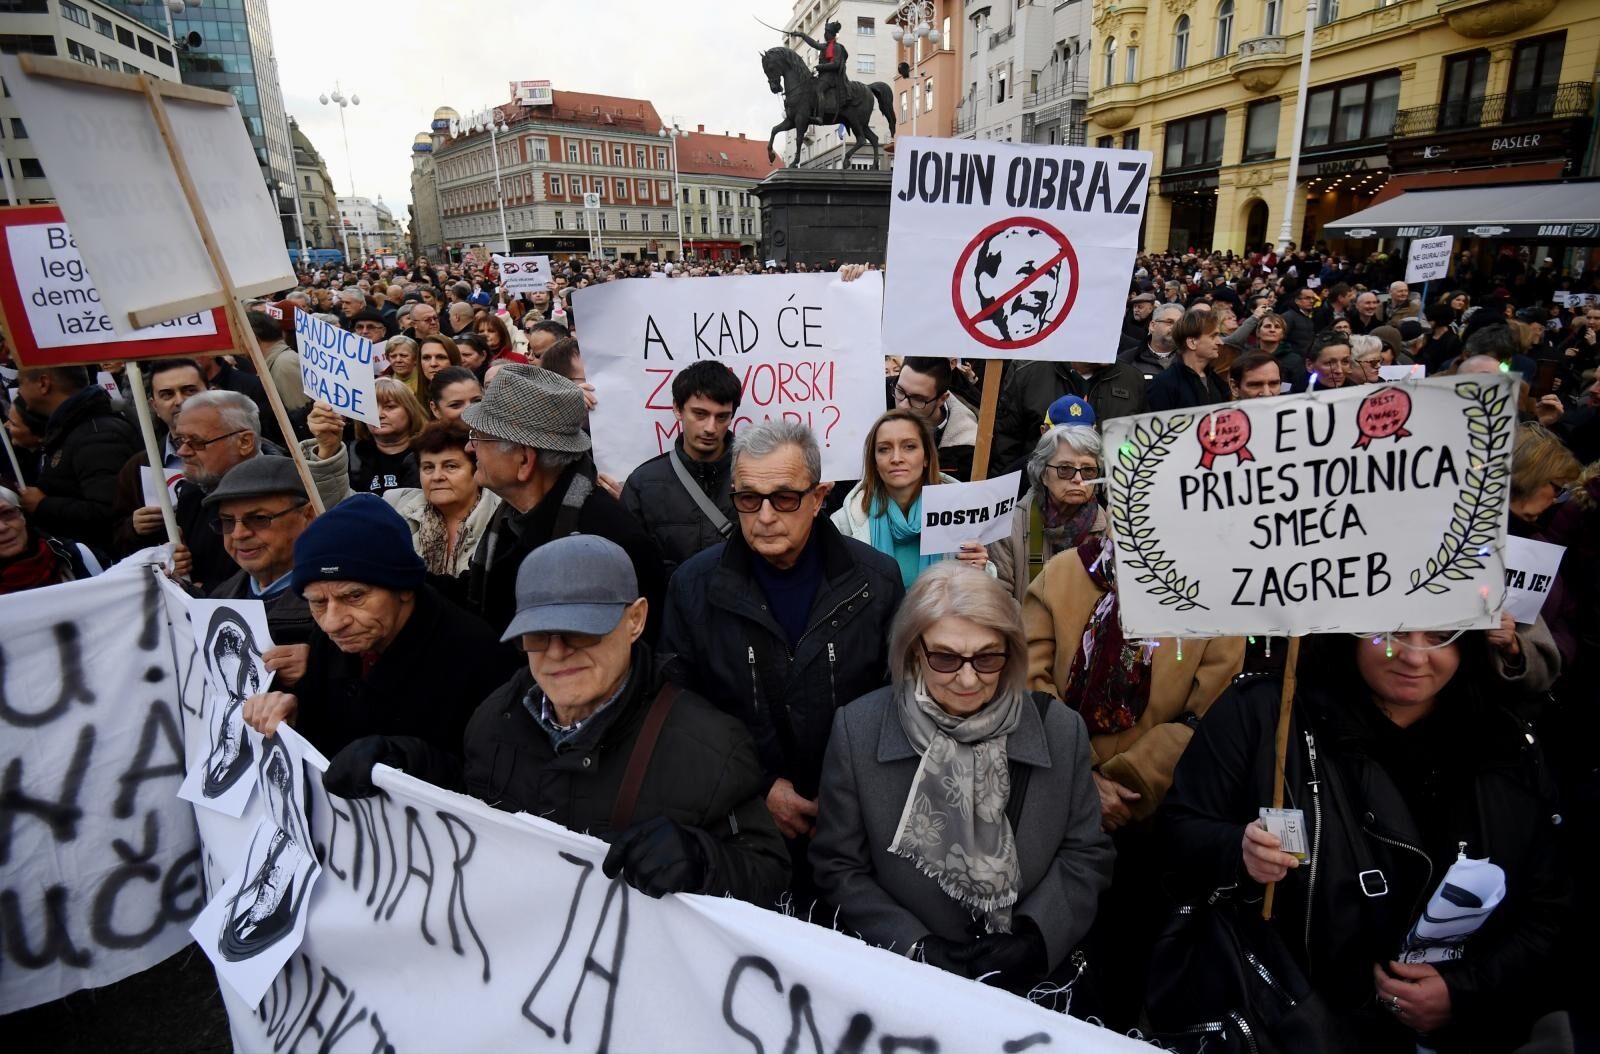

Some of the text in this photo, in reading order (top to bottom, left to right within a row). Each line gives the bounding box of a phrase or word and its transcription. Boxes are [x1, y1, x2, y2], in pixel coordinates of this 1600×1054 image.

[1317, 159, 1369, 175] HARMICA
[1491, 134, 1541, 151] BASLER
[897, 149, 1147, 215] JOHN OBRAZ
[1397, 227, 1419, 237] BABA
[1538, 225, 1568, 236] BABA
[295, 307, 373, 365] BANDICU
[644, 293, 823, 360] A KAD ĆE
[303, 341, 350, 381] DOSTA
[644, 361, 835, 410] ZVORSKI
[302, 367, 365, 416] KRAĐE
[1366, 410, 1399, 422] AWARD
[1370, 395, 1395, 407] BEST
[1275, 402, 1336, 453] EU
[1180, 445, 1459, 511] PRIJESTOLNICA
[926, 496, 1015, 528] DOSTA JE!
[1250, 499, 1368, 549] SMEĆA
[1231, 551, 1392, 606] ZAGREB
[1528, 573, 1552, 593] JE!
[521, 850, 630, 1054] ZA
